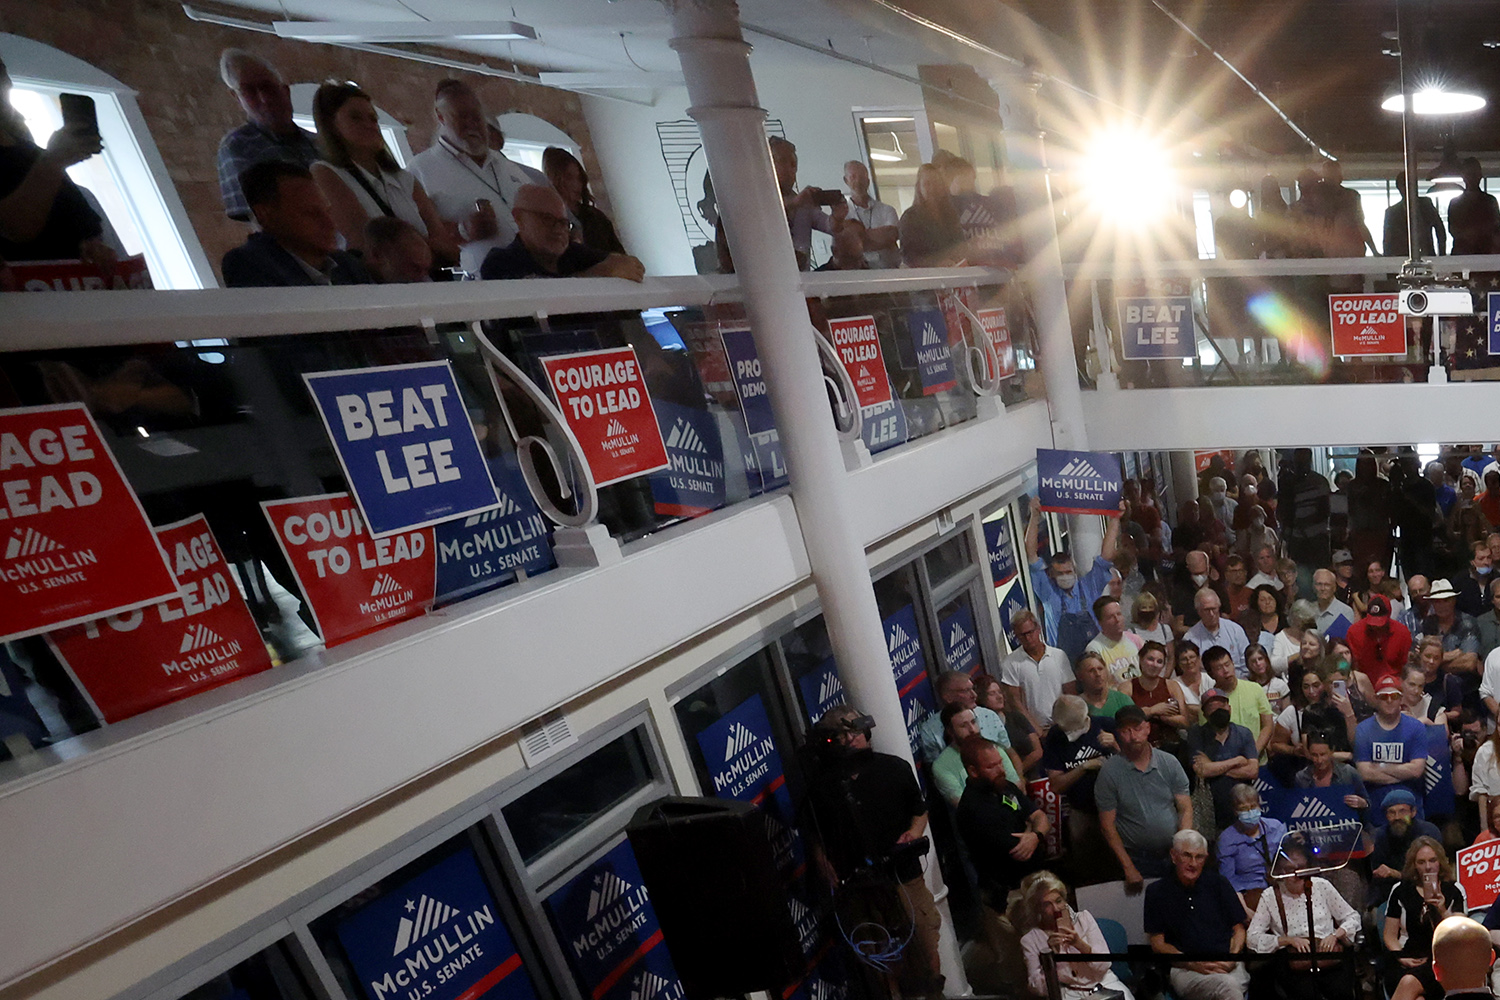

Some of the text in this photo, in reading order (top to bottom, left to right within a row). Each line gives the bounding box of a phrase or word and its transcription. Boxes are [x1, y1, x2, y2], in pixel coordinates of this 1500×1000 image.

[1126, 305, 1186, 324] BEAT
[1332, 299, 1399, 312] COURAGE
[1338, 312, 1398, 325] TO LEAD
[834, 325, 875, 346] COURAGE
[1137, 327, 1179, 345] LEE
[841, 345, 878, 364] TO LEAD
[917, 347, 951, 365] McMULLIN
[554, 360, 638, 393] COURAGE
[336, 384, 449, 441] BEAT
[568, 387, 641, 420] TO LEAD
[601, 434, 639, 451] McMULLIN
[870, 416, 897, 446] LEE
[375, 439, 461, 494] LEE
[670, 477, 714, 494] U.S. SENATE
[1041, 477, 1119, 493] McMULLIN
[1056, 491, 1105, 502] U.S. SENATE
[439, 513, 548, 563] McMULLIN
[307, 532, 426, 579] TO LEAD
[470, 545, 541, 578] U.S. SENATE
[18, 571, 87, 594] U.S. SENATE
[360, 590, 413, 615] McMULLIN
[161, 640, 243, 676] McMULLIN
[189, 659, 240, 683] U.S. SENATE
[714, 736, 775, 791] McMULLIN
[1376, 745, 1401, 760] BYU
[731, 762, 769, 797] U.S. SENATE
[1466, 862, 1491, 877] TO
[616, 911, 648, 946] SENATE
[436, 943, 484, 985] SENATE
